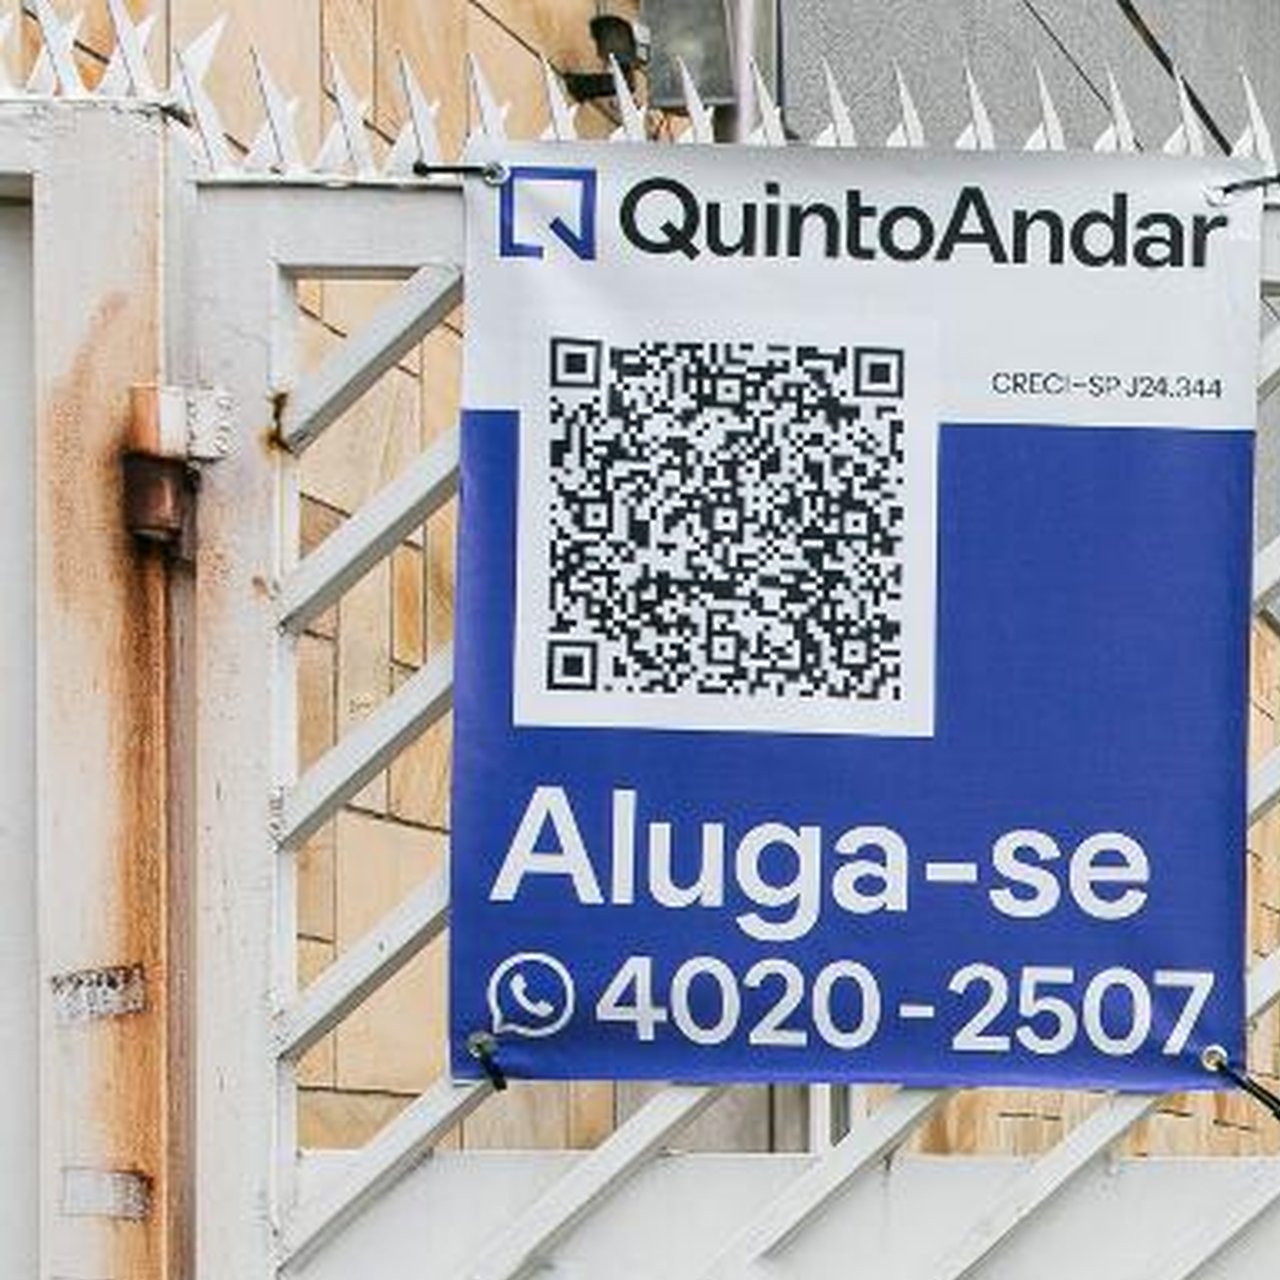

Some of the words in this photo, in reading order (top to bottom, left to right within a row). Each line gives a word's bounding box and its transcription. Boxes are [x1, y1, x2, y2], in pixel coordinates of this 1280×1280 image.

[619, 176, 1228, 269] QuintoAndar
[992, 371, 1121, 398] CRECI-SP
[1125, 376, 1223, 398] J24.344
[489, 785, 1151, 942] Aluga-se
